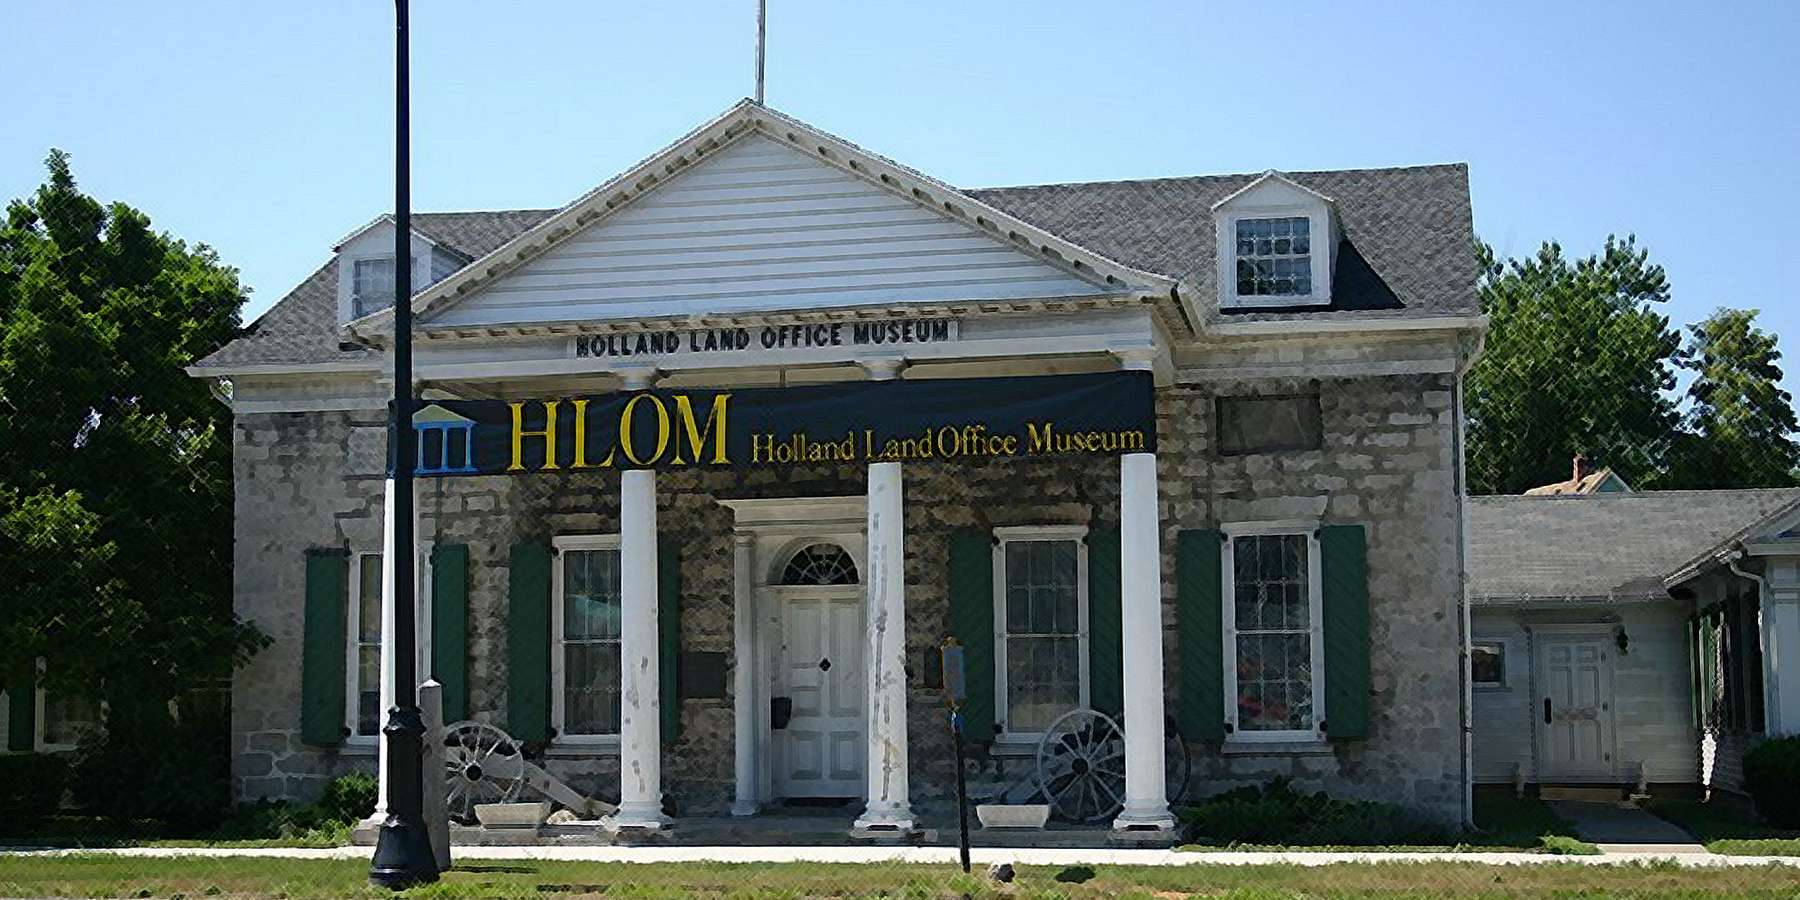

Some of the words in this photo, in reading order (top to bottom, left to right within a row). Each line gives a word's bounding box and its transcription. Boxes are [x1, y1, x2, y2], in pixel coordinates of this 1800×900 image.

[576, 331, 680, 358] HOLLAND
[690, 327, 750, 352] LAND
[760, 322, 842, 349] OFFICE
[853, 319, 949, 344] MUSEUM
[507, 393, 732, 472] HLOM
[751, 430, 854, 464] Holland
[864, 427, 932, 461] Land
[938, 424, 1018, 458] Office
[1025, 422, 1145, 455] Museum
